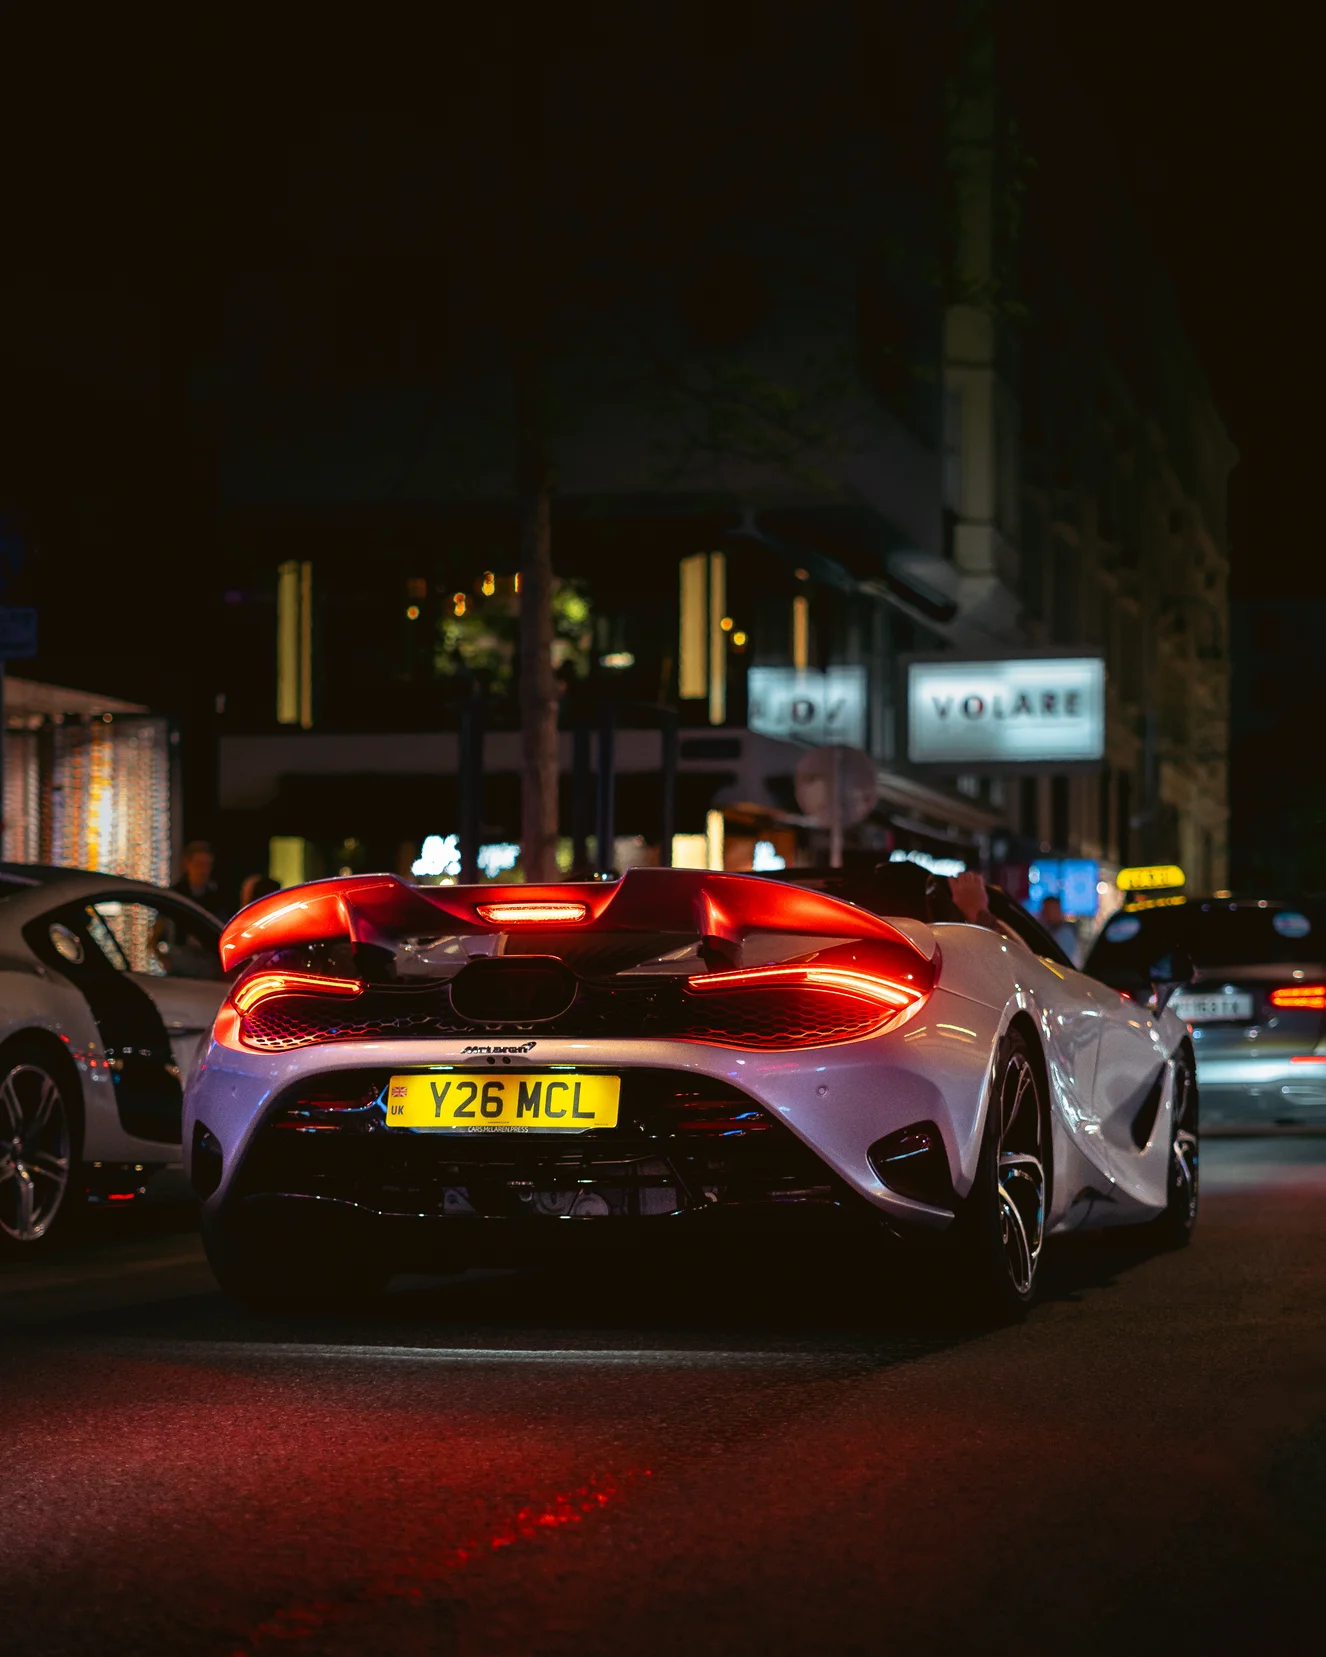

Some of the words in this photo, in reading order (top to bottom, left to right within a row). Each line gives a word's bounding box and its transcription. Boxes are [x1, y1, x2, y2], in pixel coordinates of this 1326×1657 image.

[930, 690, 1081, 721] VOLARE
[391, 1105, 405, 1115] UK
[430, 1081, 505, 1119] Y26
[516, 1081, 596, 1119] MCL
